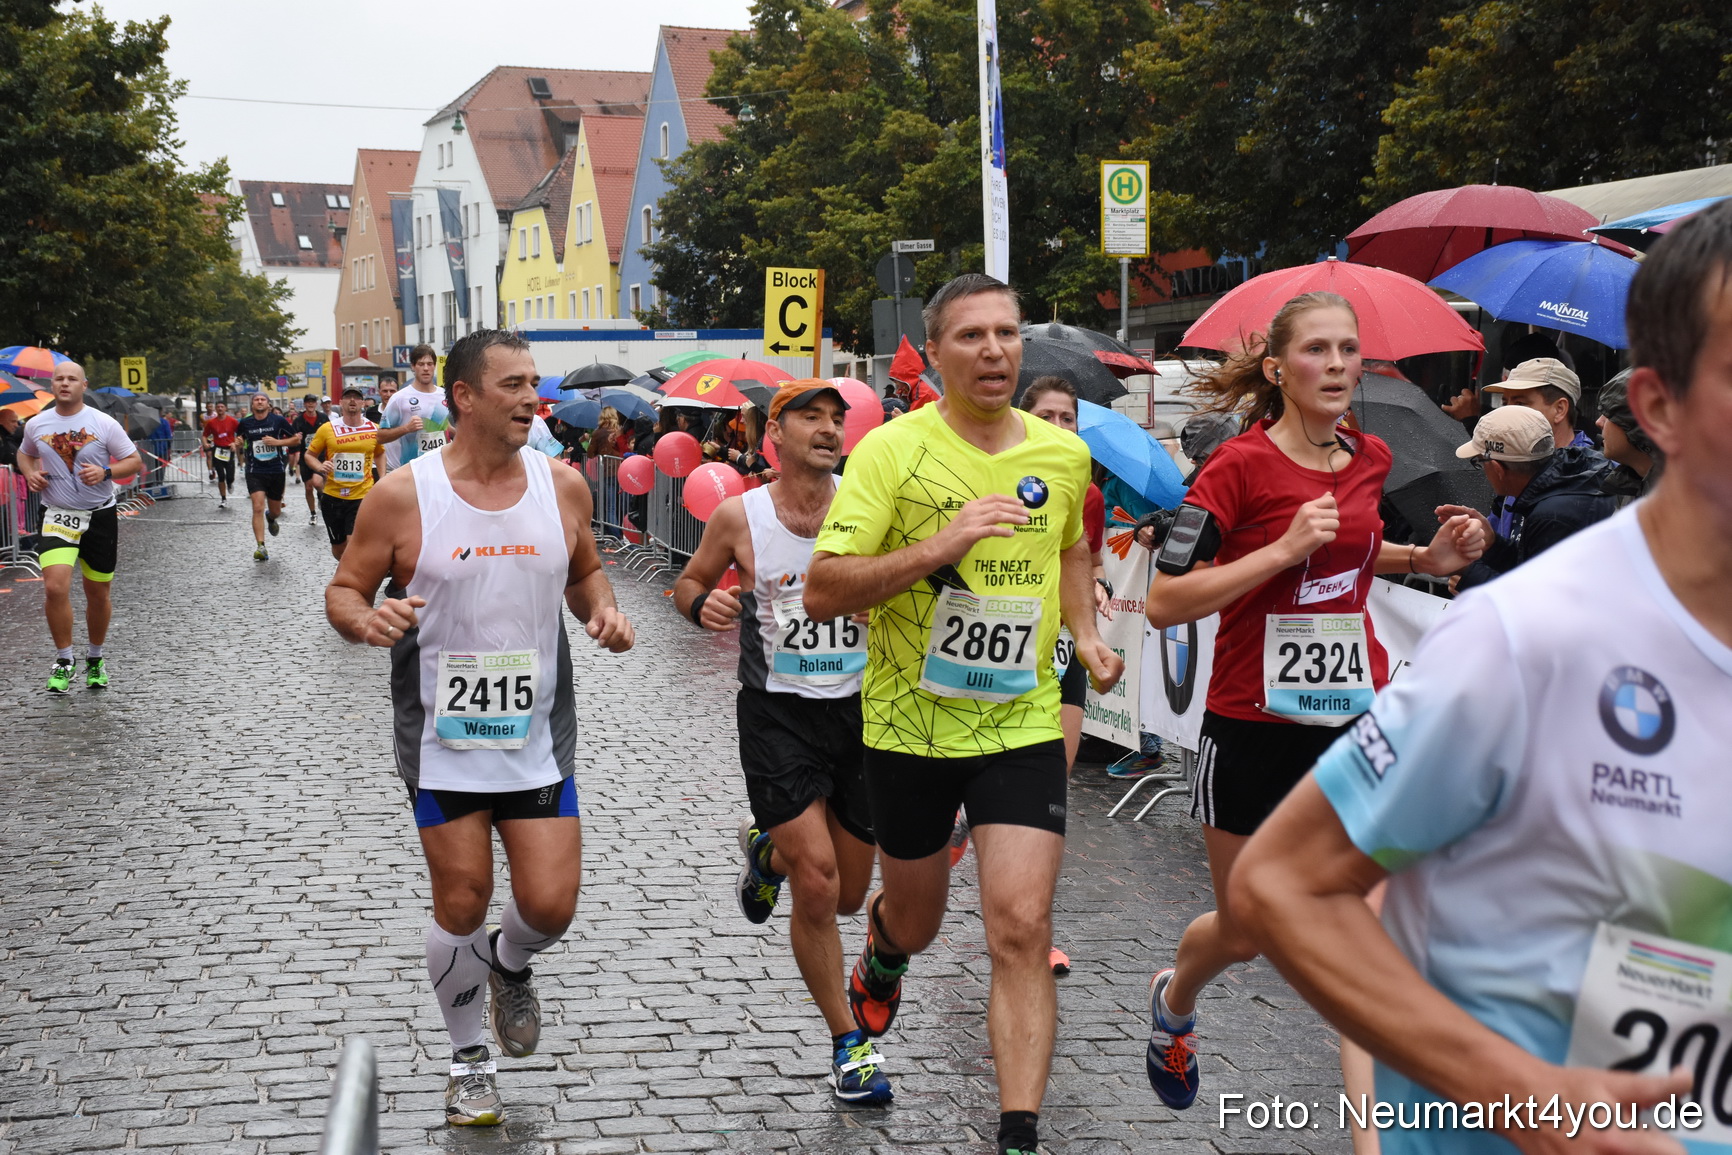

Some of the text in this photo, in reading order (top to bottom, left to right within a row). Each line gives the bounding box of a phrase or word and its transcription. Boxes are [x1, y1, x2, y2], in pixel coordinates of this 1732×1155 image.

[1110, 207, 1139, 215] Marktplatz
[900, 241, 932, 250] Ulmer Gasse
[526, 276, 541, 292] HOTEL
[773, 271, 817, 288] Block
[778, 294, 808, 338] C
[1539, 300, 1589, 322] MAINTAL
[123, 358, 143, 366] Block
[128, 368, 141, 385] D
[336, 436, 357, 445] MAX
[336, 459, 362, 471] 2813
[707, 469, 727, 497] RÖDL
[1024, 514, 1048, 526] artl
[475, 545, 541, 557] KLEBL
[975, 560, 1031, 573] THE NEXT
[984, 574, 1045, 586] 100 YEARS
[946, 600, 980, 613] NeuerMarkt
[985, 600, 1034, 615] BOCK
[783, 616, 860, 650] 2315
[1321, 618, 1362, 632] BOCK
[940, 615, 1032, 664] 2867
[484, 654, 532, 668] BOCK
[800, 658, 843, 672] Roland
[1278, 642, 1364, 684] 2324
[966, 671, 994, 688] Ulli
[447, 675, 533, 712] 2415
[1298, 695, 1351, 711] Marina
[464, 722, 516, 736] Werner
[1592, 763, 1681, 800] PARTL
[537, 787, 550, 805] GOR
[1590, 789, 1682, 818] Neumarkt
[1617, 963, 1713, 1000] NeuerMarkt
